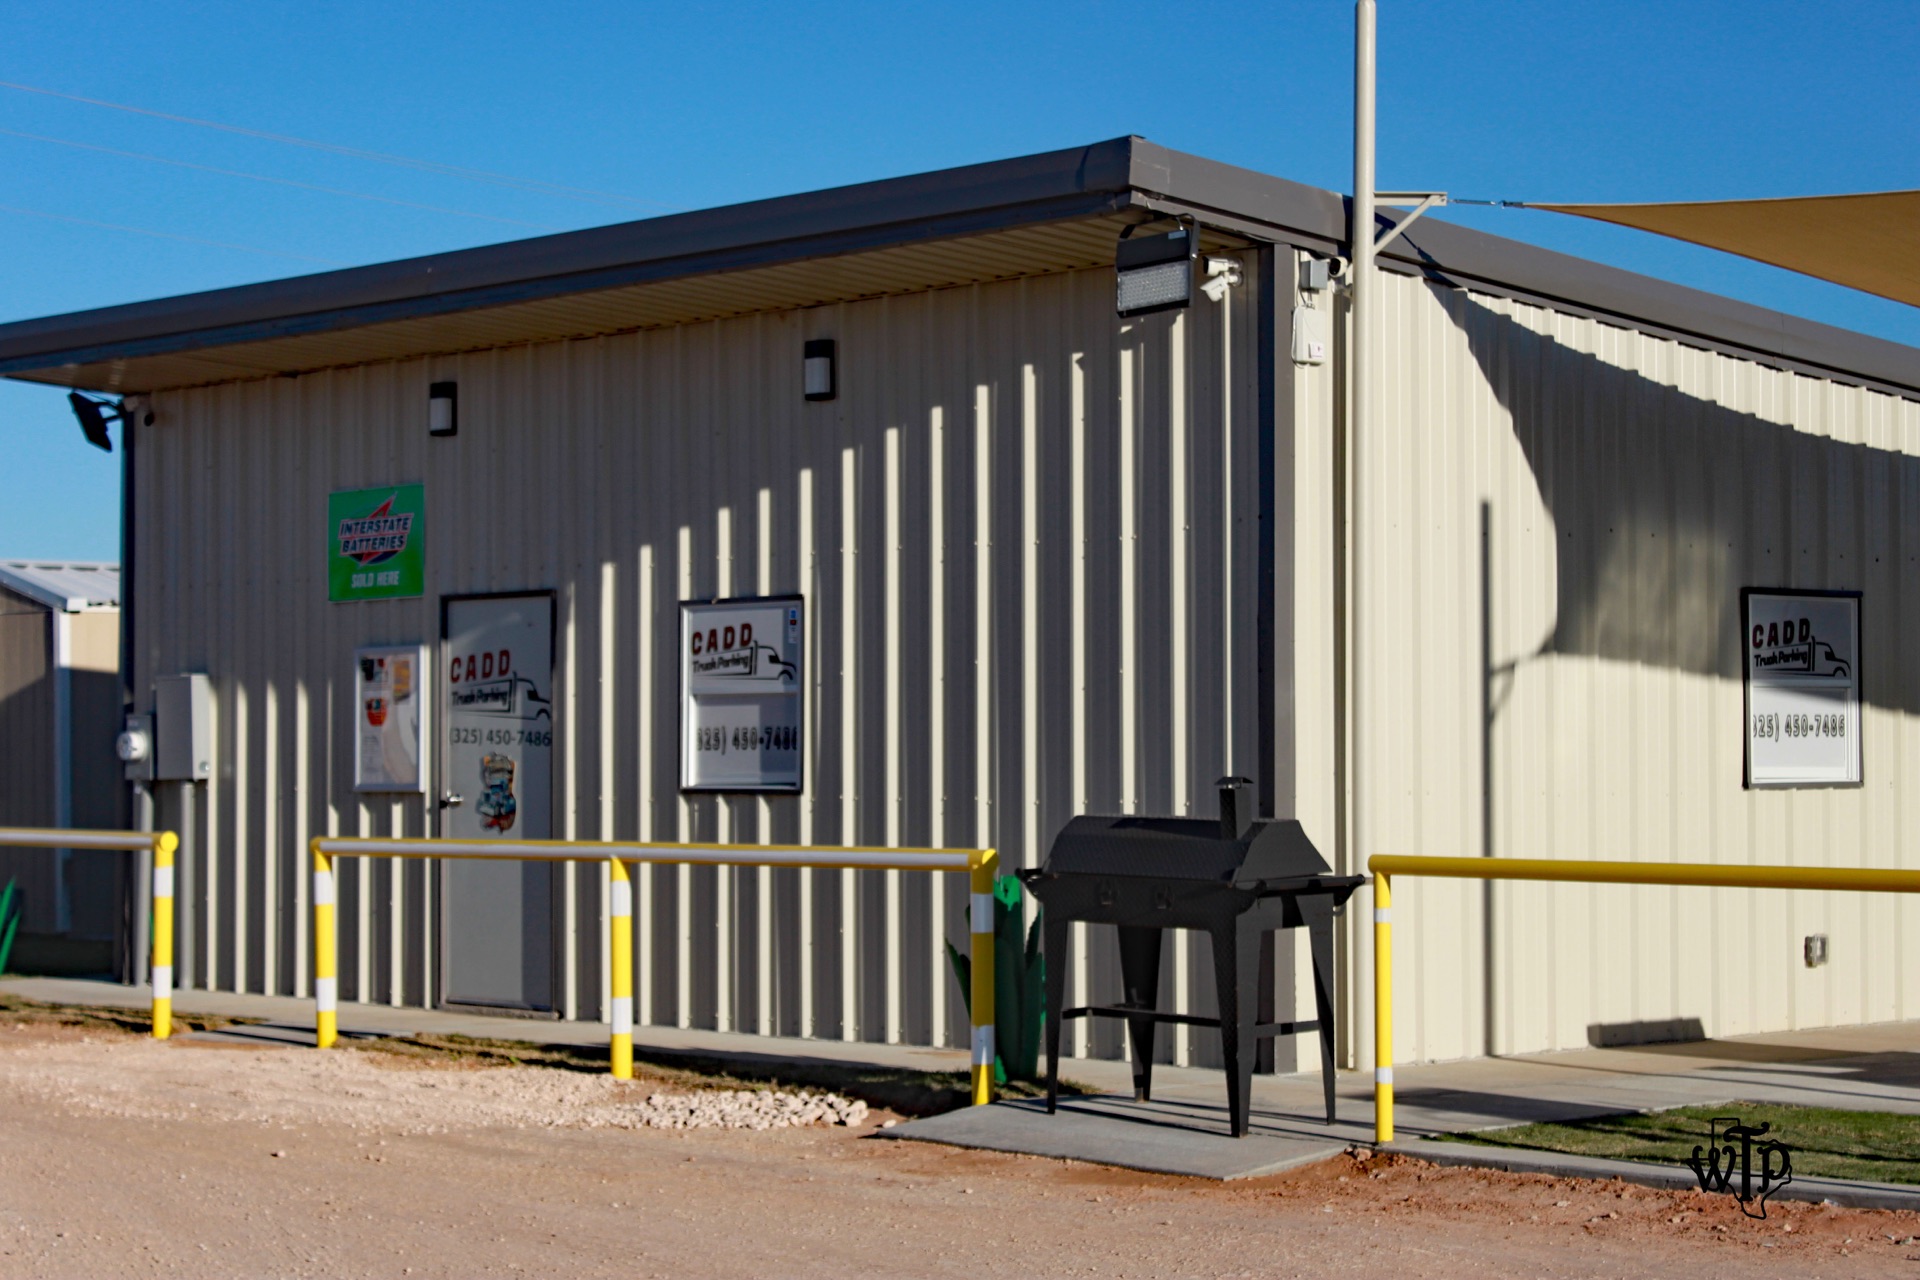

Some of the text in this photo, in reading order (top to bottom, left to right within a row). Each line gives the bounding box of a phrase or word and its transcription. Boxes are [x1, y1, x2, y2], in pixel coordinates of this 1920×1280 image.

[340, 518, 409, 535] INTERSTATE
[342, 535, 403, 552] BATTERIES
[351, 571, 399, 588] SOLD HERE
[692, 623, 752, 655] CADD
[1752, 618, 1811, 648] CADD
[451, 649, 510, 683] CADD
[693, 652, 750, 673] Truck Parking
[1754, 648, 1808, 667] Truck Parking
[1785, 714, 1845, 738] 450-7486
